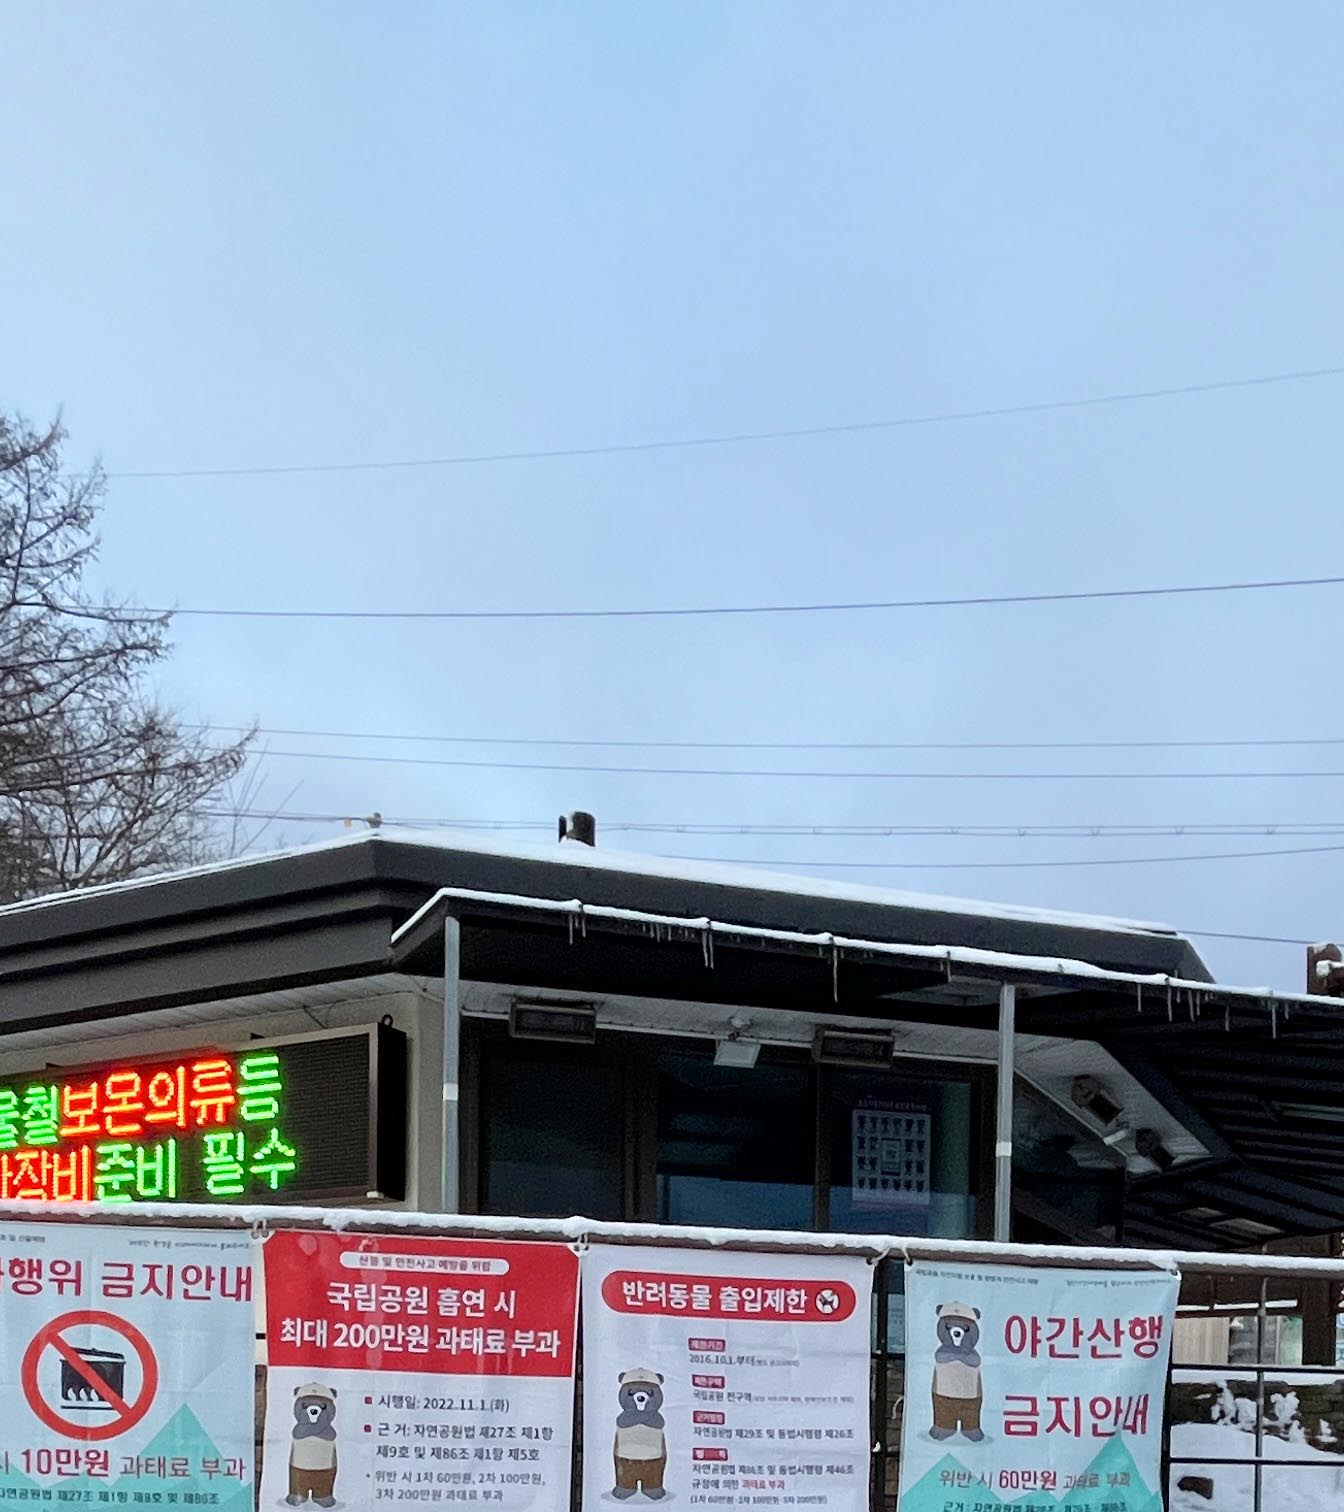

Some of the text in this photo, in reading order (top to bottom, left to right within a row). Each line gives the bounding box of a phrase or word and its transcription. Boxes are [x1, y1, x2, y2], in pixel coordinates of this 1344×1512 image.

[203, 1127, 297, 1196] 필수
[395, 1257, 435, 1269] 안전사고
[101, 1262, 253, 1302] 금지안내
[326, 1281, 516, 1319] 국립공원 흡연 시
[622, 1281, 807, 1314] 반려동물 출입제한
[280, 1318, 560, 1358] 최대 200만원 과태료 부과
[1005, 1314, 1163, 1359] 야간산행
[378, 1395, 420, 1409] 시행일:
[1003, 1394, 1149, 1437] 금지안내
[377, 1423, 391, 1437] 근
[414, 1424, 475, 1439] 자연공원법
[479, 1426, 517, 1440] 제27조
[521, 1426, 553, 1441] 제1항
[21, 1448, 109, 1477] 10만원
[120, 1456, 191, 1479] 과태료
[200, 1457, 246, 1480] 부과
[376, 1445, 540, 1461] 제9호 및 제86조 제1항 제5호
[375, 1470, 397, 1482] 위반
[401, 1471, 412, 1482] 시
[416, 1471, 433, 1483] 1차
[479, 1472, 496, 1484] 2차
[939, 1469, 973, 1488] 위반
[977, 1471, 993, 1489] 시
[999, 1469, 1057, 1491] 60만원
[57, 1489, 93, 1502] 제27조
[375, 1488, 503, 1501] 3차 200만원 과태료 부과
[943, 1501, 964, 1512] 근거
